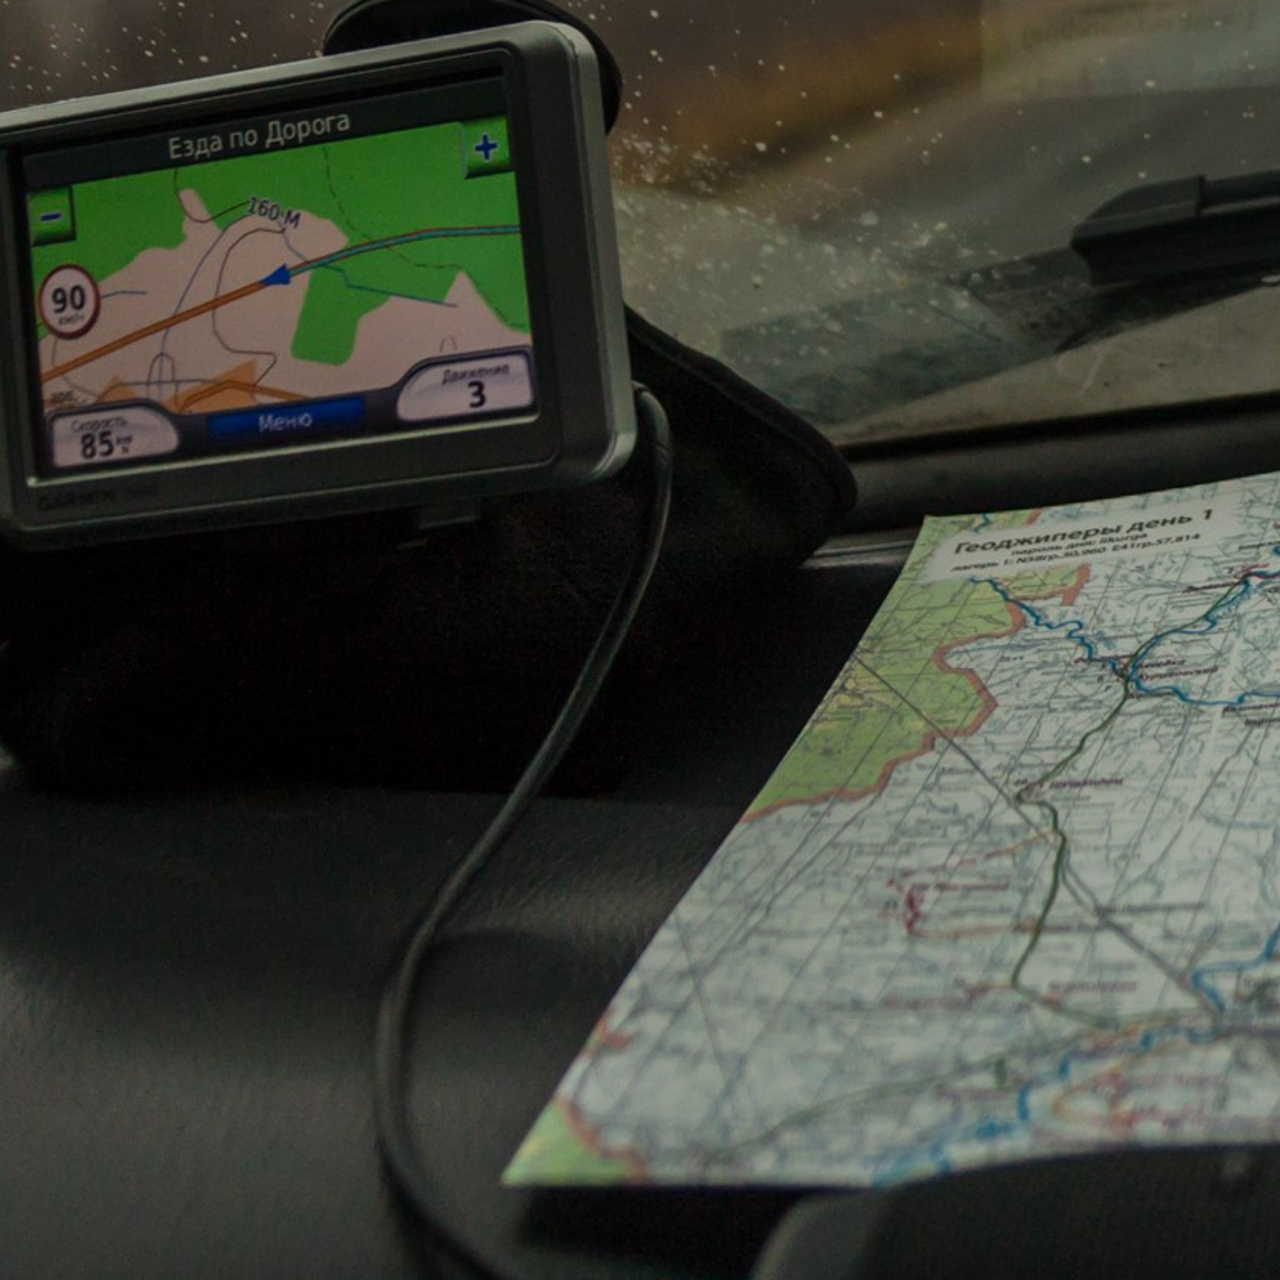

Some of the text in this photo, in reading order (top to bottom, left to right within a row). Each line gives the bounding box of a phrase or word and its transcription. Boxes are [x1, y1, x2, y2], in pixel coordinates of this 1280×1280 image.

[169, 113, 350, 159] Езда по Дорога
[245, 197, 280, 222] 160
[51, 284, 85, 314] 90
[257, 412, 312, 433] Меню
[81, 430, 115, 459] 85
[954, 509, 1213, 556] Геоджиперы день 1
